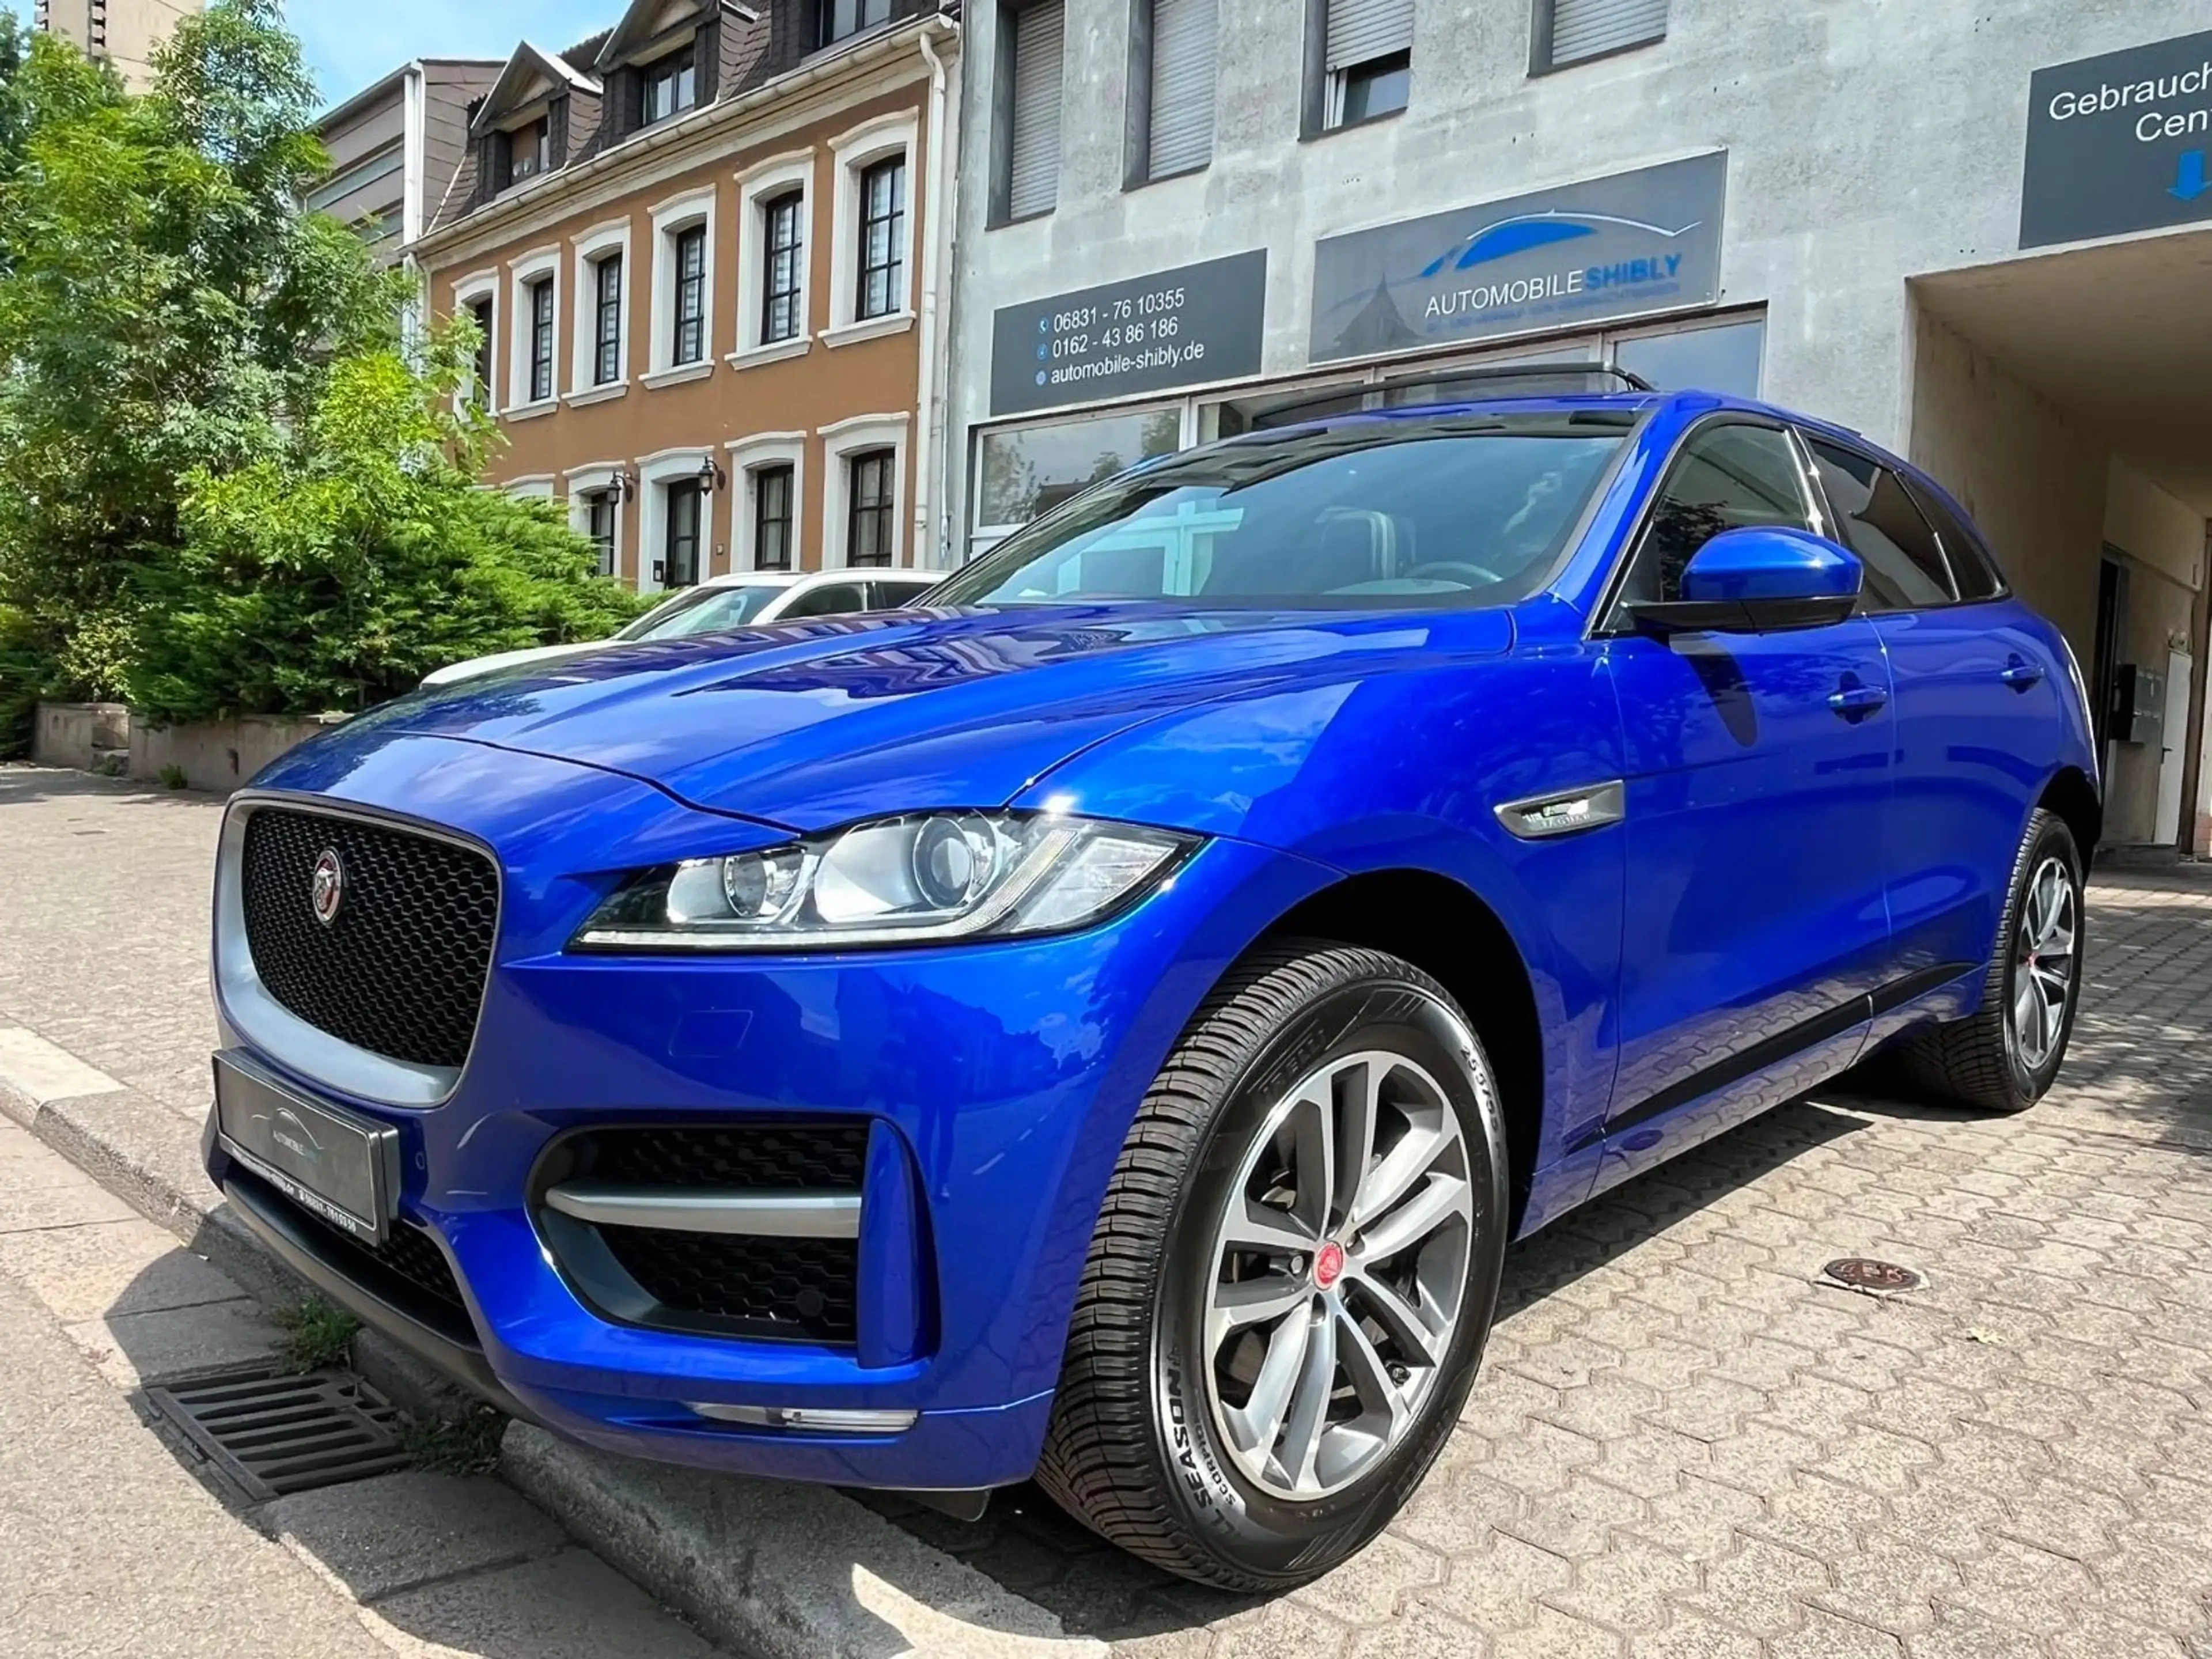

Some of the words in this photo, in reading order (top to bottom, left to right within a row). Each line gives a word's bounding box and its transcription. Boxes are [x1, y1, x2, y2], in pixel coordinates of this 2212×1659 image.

[2135, 108, 2212, 142] Cen
[1053, 306, 1096, 333] 06831
[1113, 299, 1132, 321] 76
[1137, 287, 1185, 315] 10355
[1052, 334, 1088, 359] 0162
[1102, 329, 1120, 348] 43
[1125, 323, 1145, 343] 86
[1150, 316, 1179, 340] 186
[1051, 341, 1205, 384] automobile-shibly.de
[1167, 1368, 1214, 1510] SEASON
